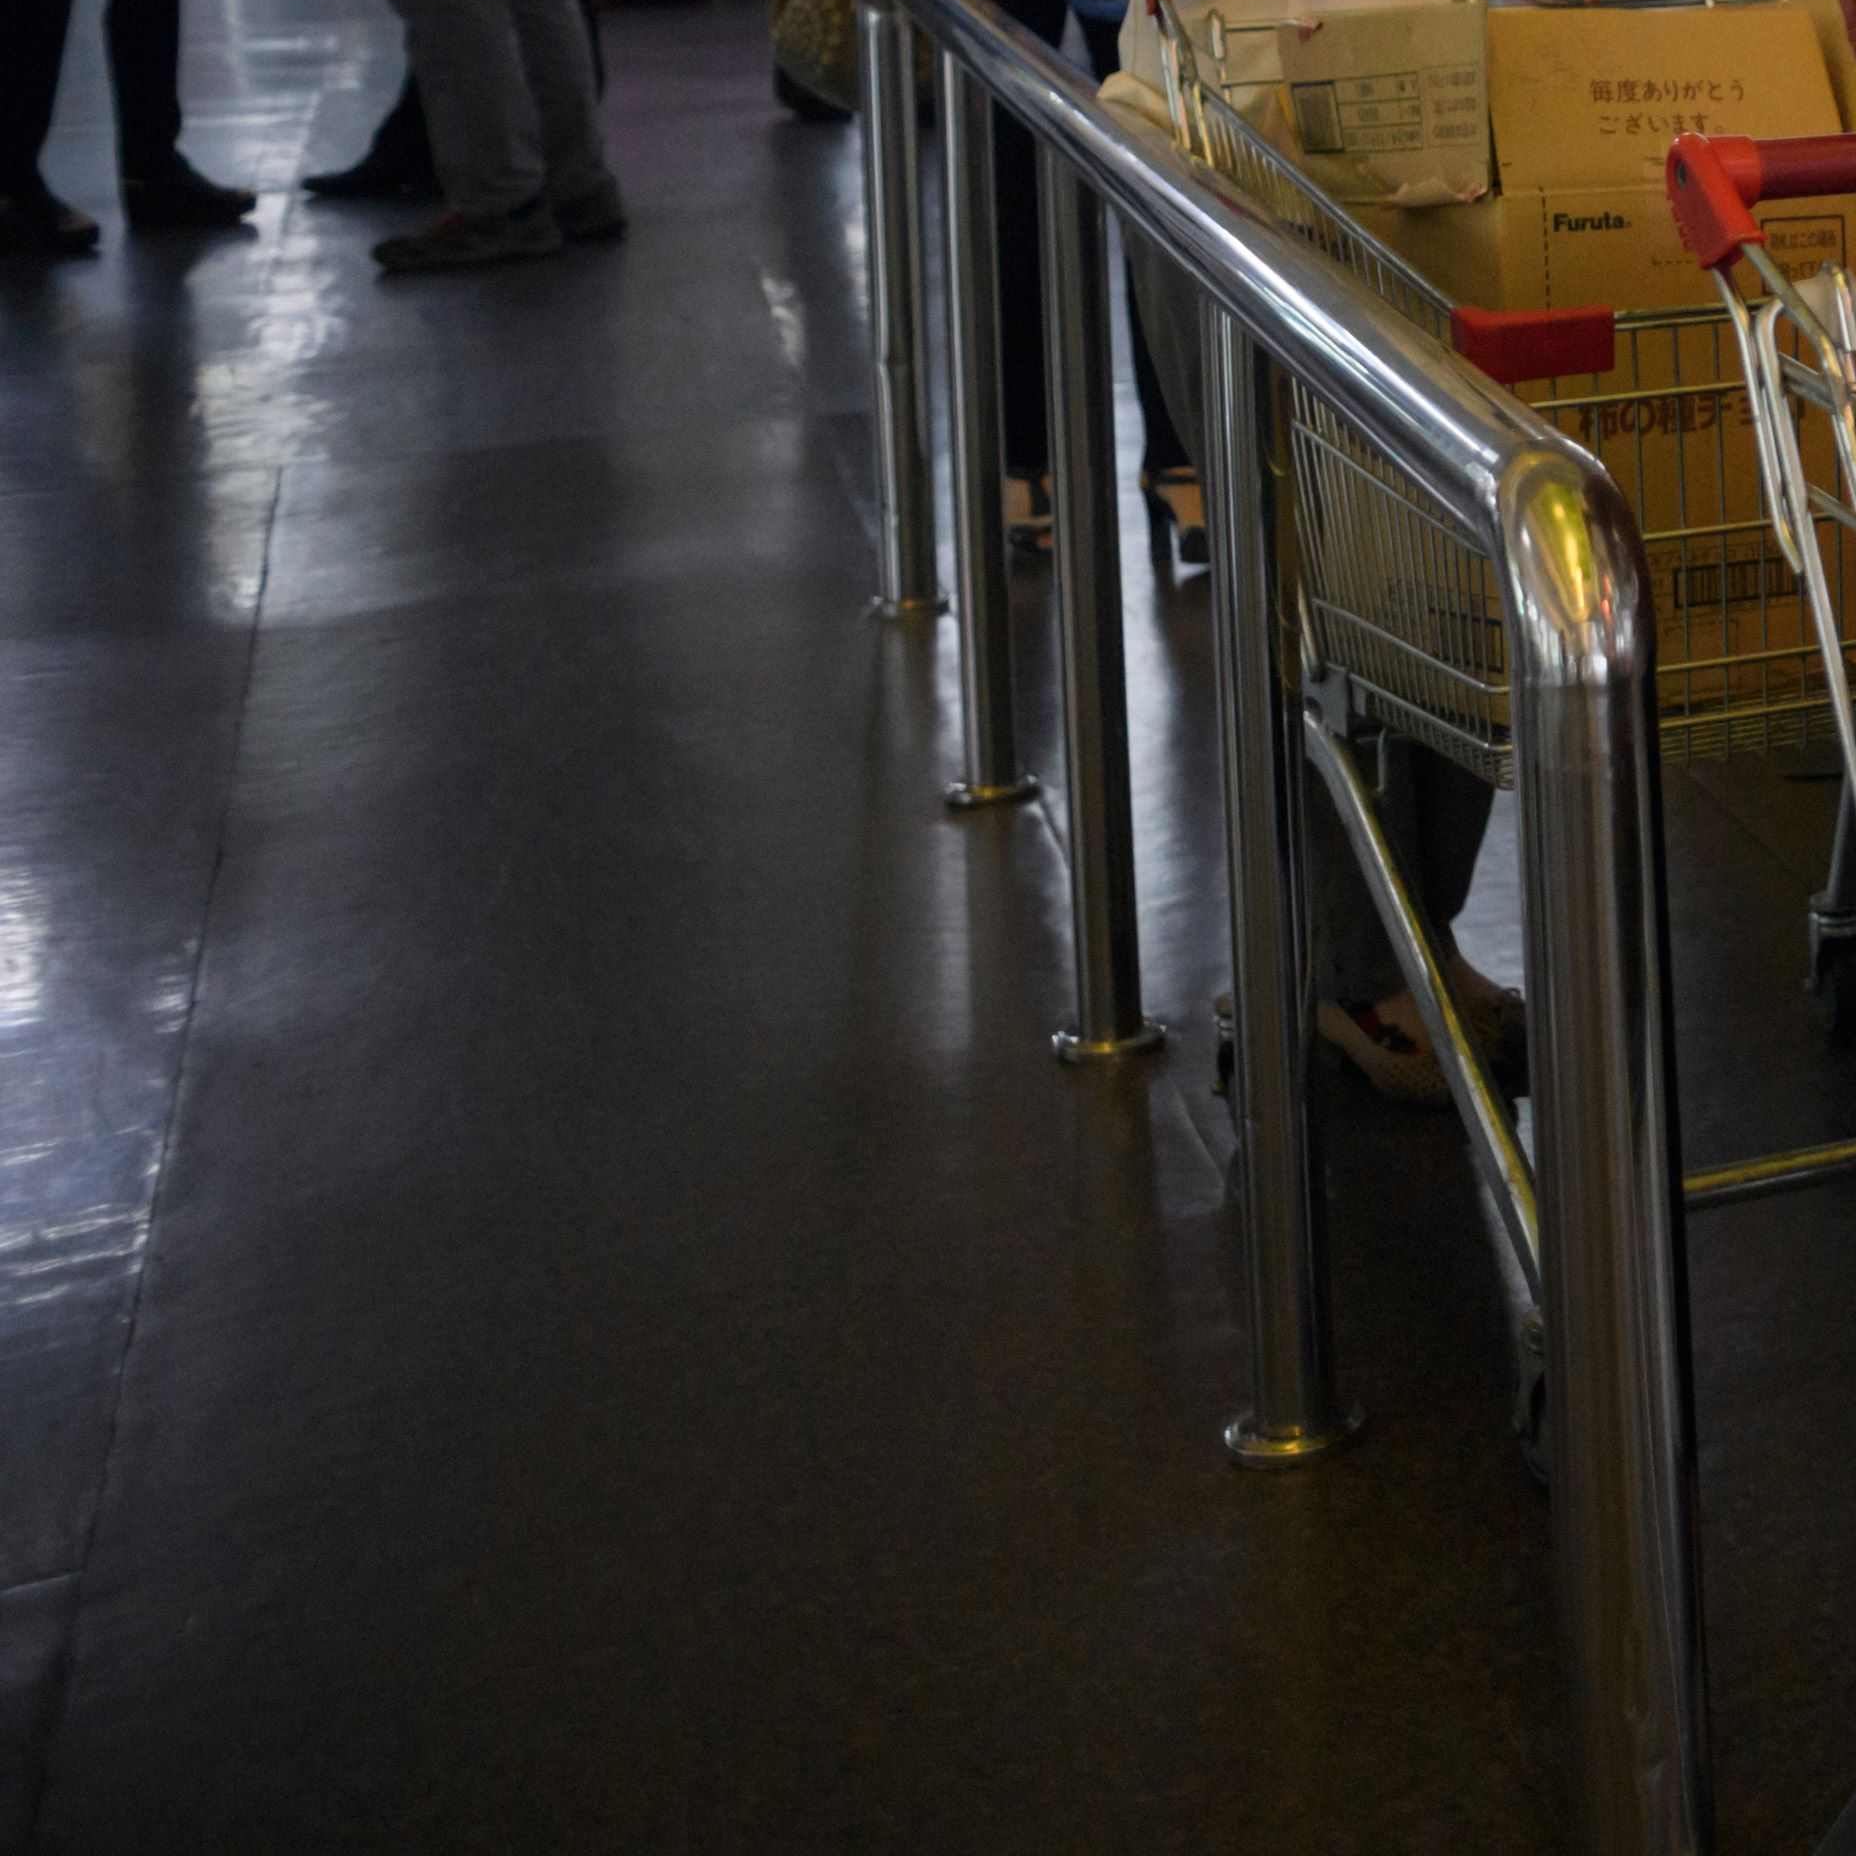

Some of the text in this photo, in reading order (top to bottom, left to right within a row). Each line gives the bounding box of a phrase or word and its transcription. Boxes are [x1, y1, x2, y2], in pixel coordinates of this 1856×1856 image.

[1590, 79, 1746, 104] 毎度ありがとう
[1552, 210, 1625, 233] Furuta
